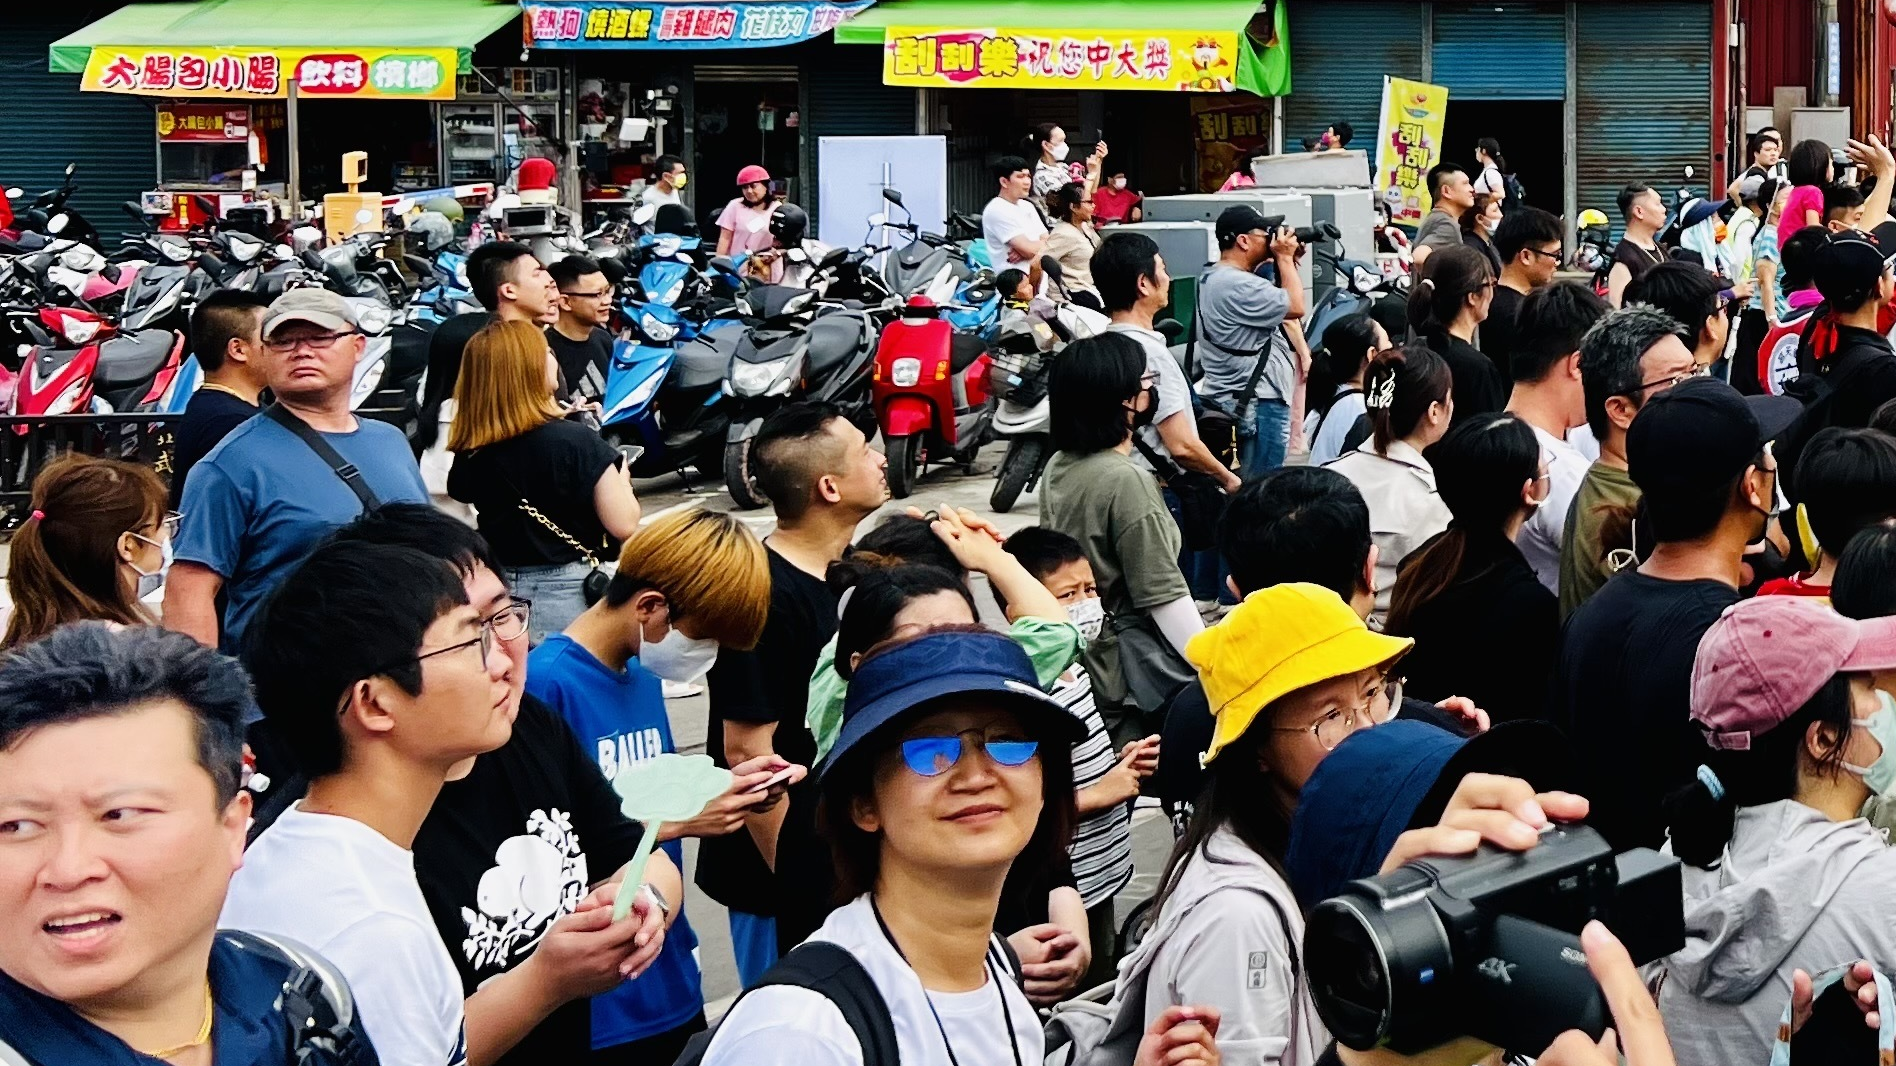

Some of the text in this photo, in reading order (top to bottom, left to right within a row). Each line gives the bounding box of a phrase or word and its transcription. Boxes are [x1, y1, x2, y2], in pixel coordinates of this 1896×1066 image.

[532, 8, 583, 40] 熱狗
[102, 55, 280, 94] 大腸包小腸
[299, 60, 365, 87] 飲料
[893, 36, 1172, 81] 刮刮樂 祝您中大獎
[1396, 122, 1431, 190] 刮刮樂
